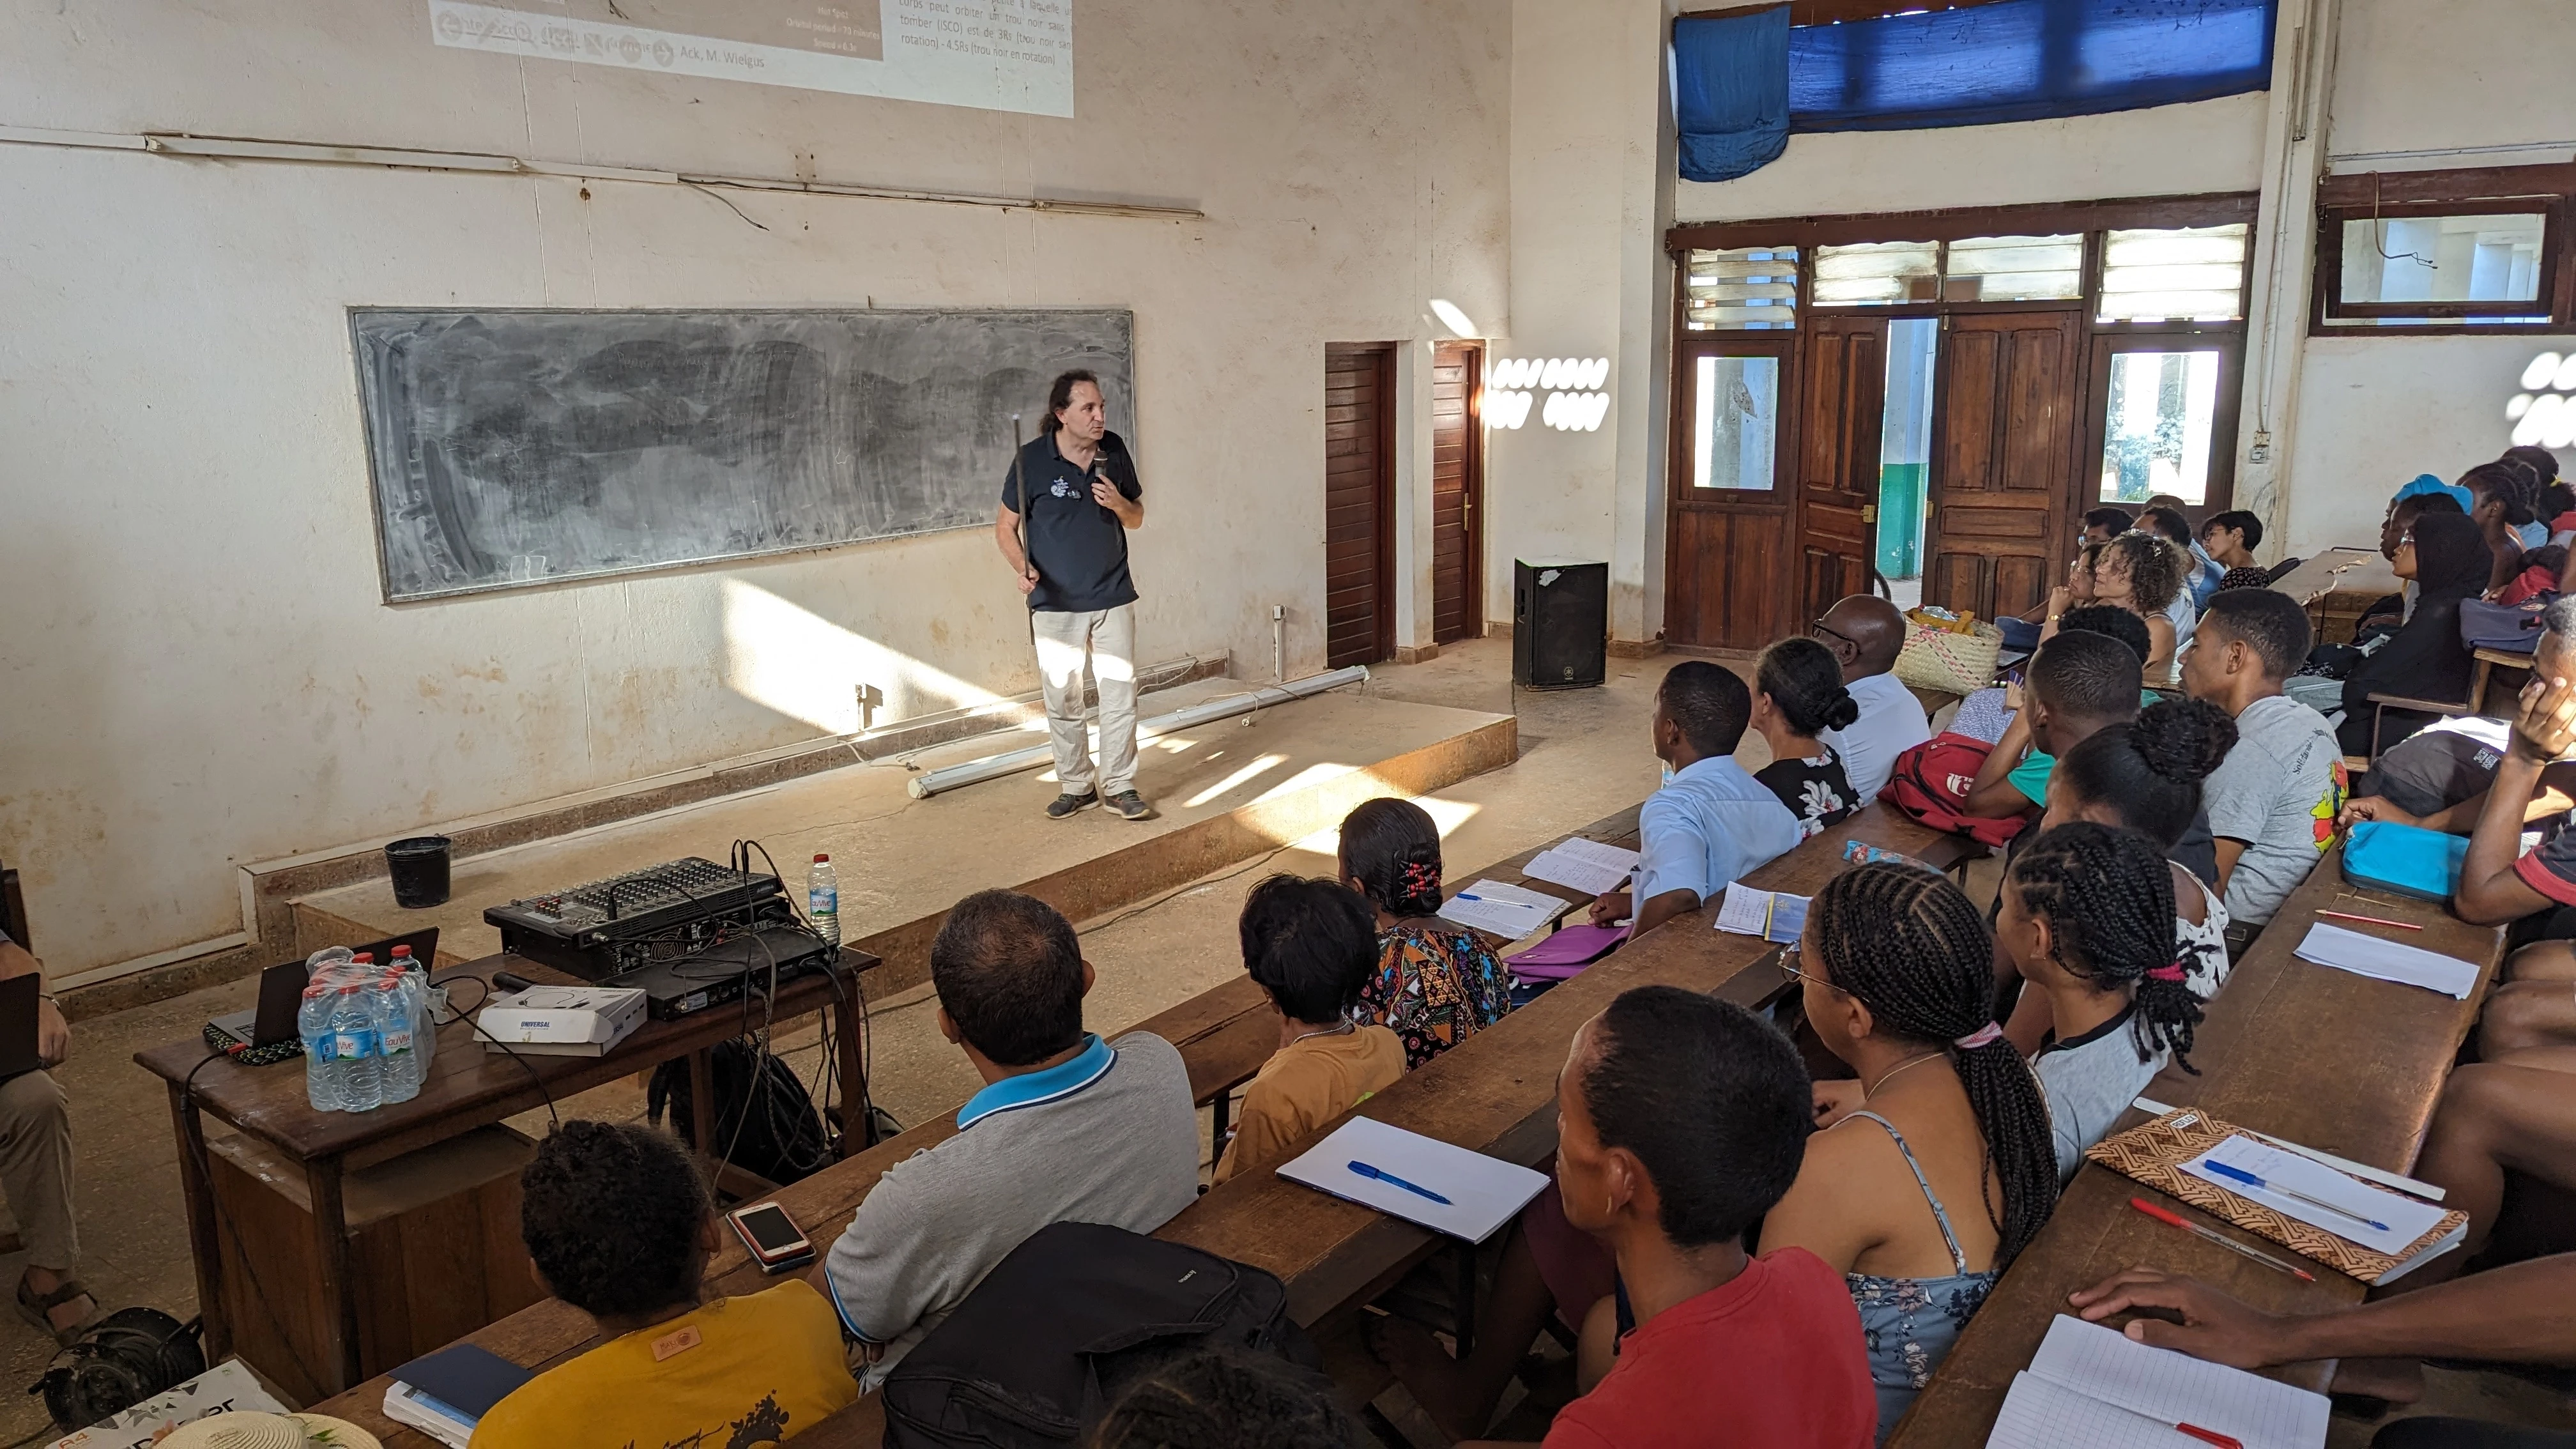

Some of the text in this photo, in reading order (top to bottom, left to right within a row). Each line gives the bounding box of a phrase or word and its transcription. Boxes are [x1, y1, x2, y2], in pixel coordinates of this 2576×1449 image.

[930, 3, 949, 13] peut
[955, 6, 984, 18] orbiter
[990, 12, 1000, 20] un
[1006, 13, 1022, 24] trou
[1028, 19, 1043, 28] noir
[1048, 22, 1065, 32] sans
[1030, 0, 1059, 13] laquelle
[900, 15, 1071, 50] tomber (ISCO) est de 3Rs (trou noir san
[680, 46, 703, 62] Ack,
[706, 49, 721, 62] M.
[723, 51, 765, 68] Wielgus
[901, 34, 939, 50] rotation)
[946, 40, 969, 52] 4.5Rs
[971, 42, 991, 56] (trou
[993, 47, 1008, 57] noir
[1011, 51, 1020, 60] en
[1022, 51, 1055, 65] rotation)
[385, 1033, 411, 1046] EauVive
[2172, 1115, 2196, 1127] REFLEX
